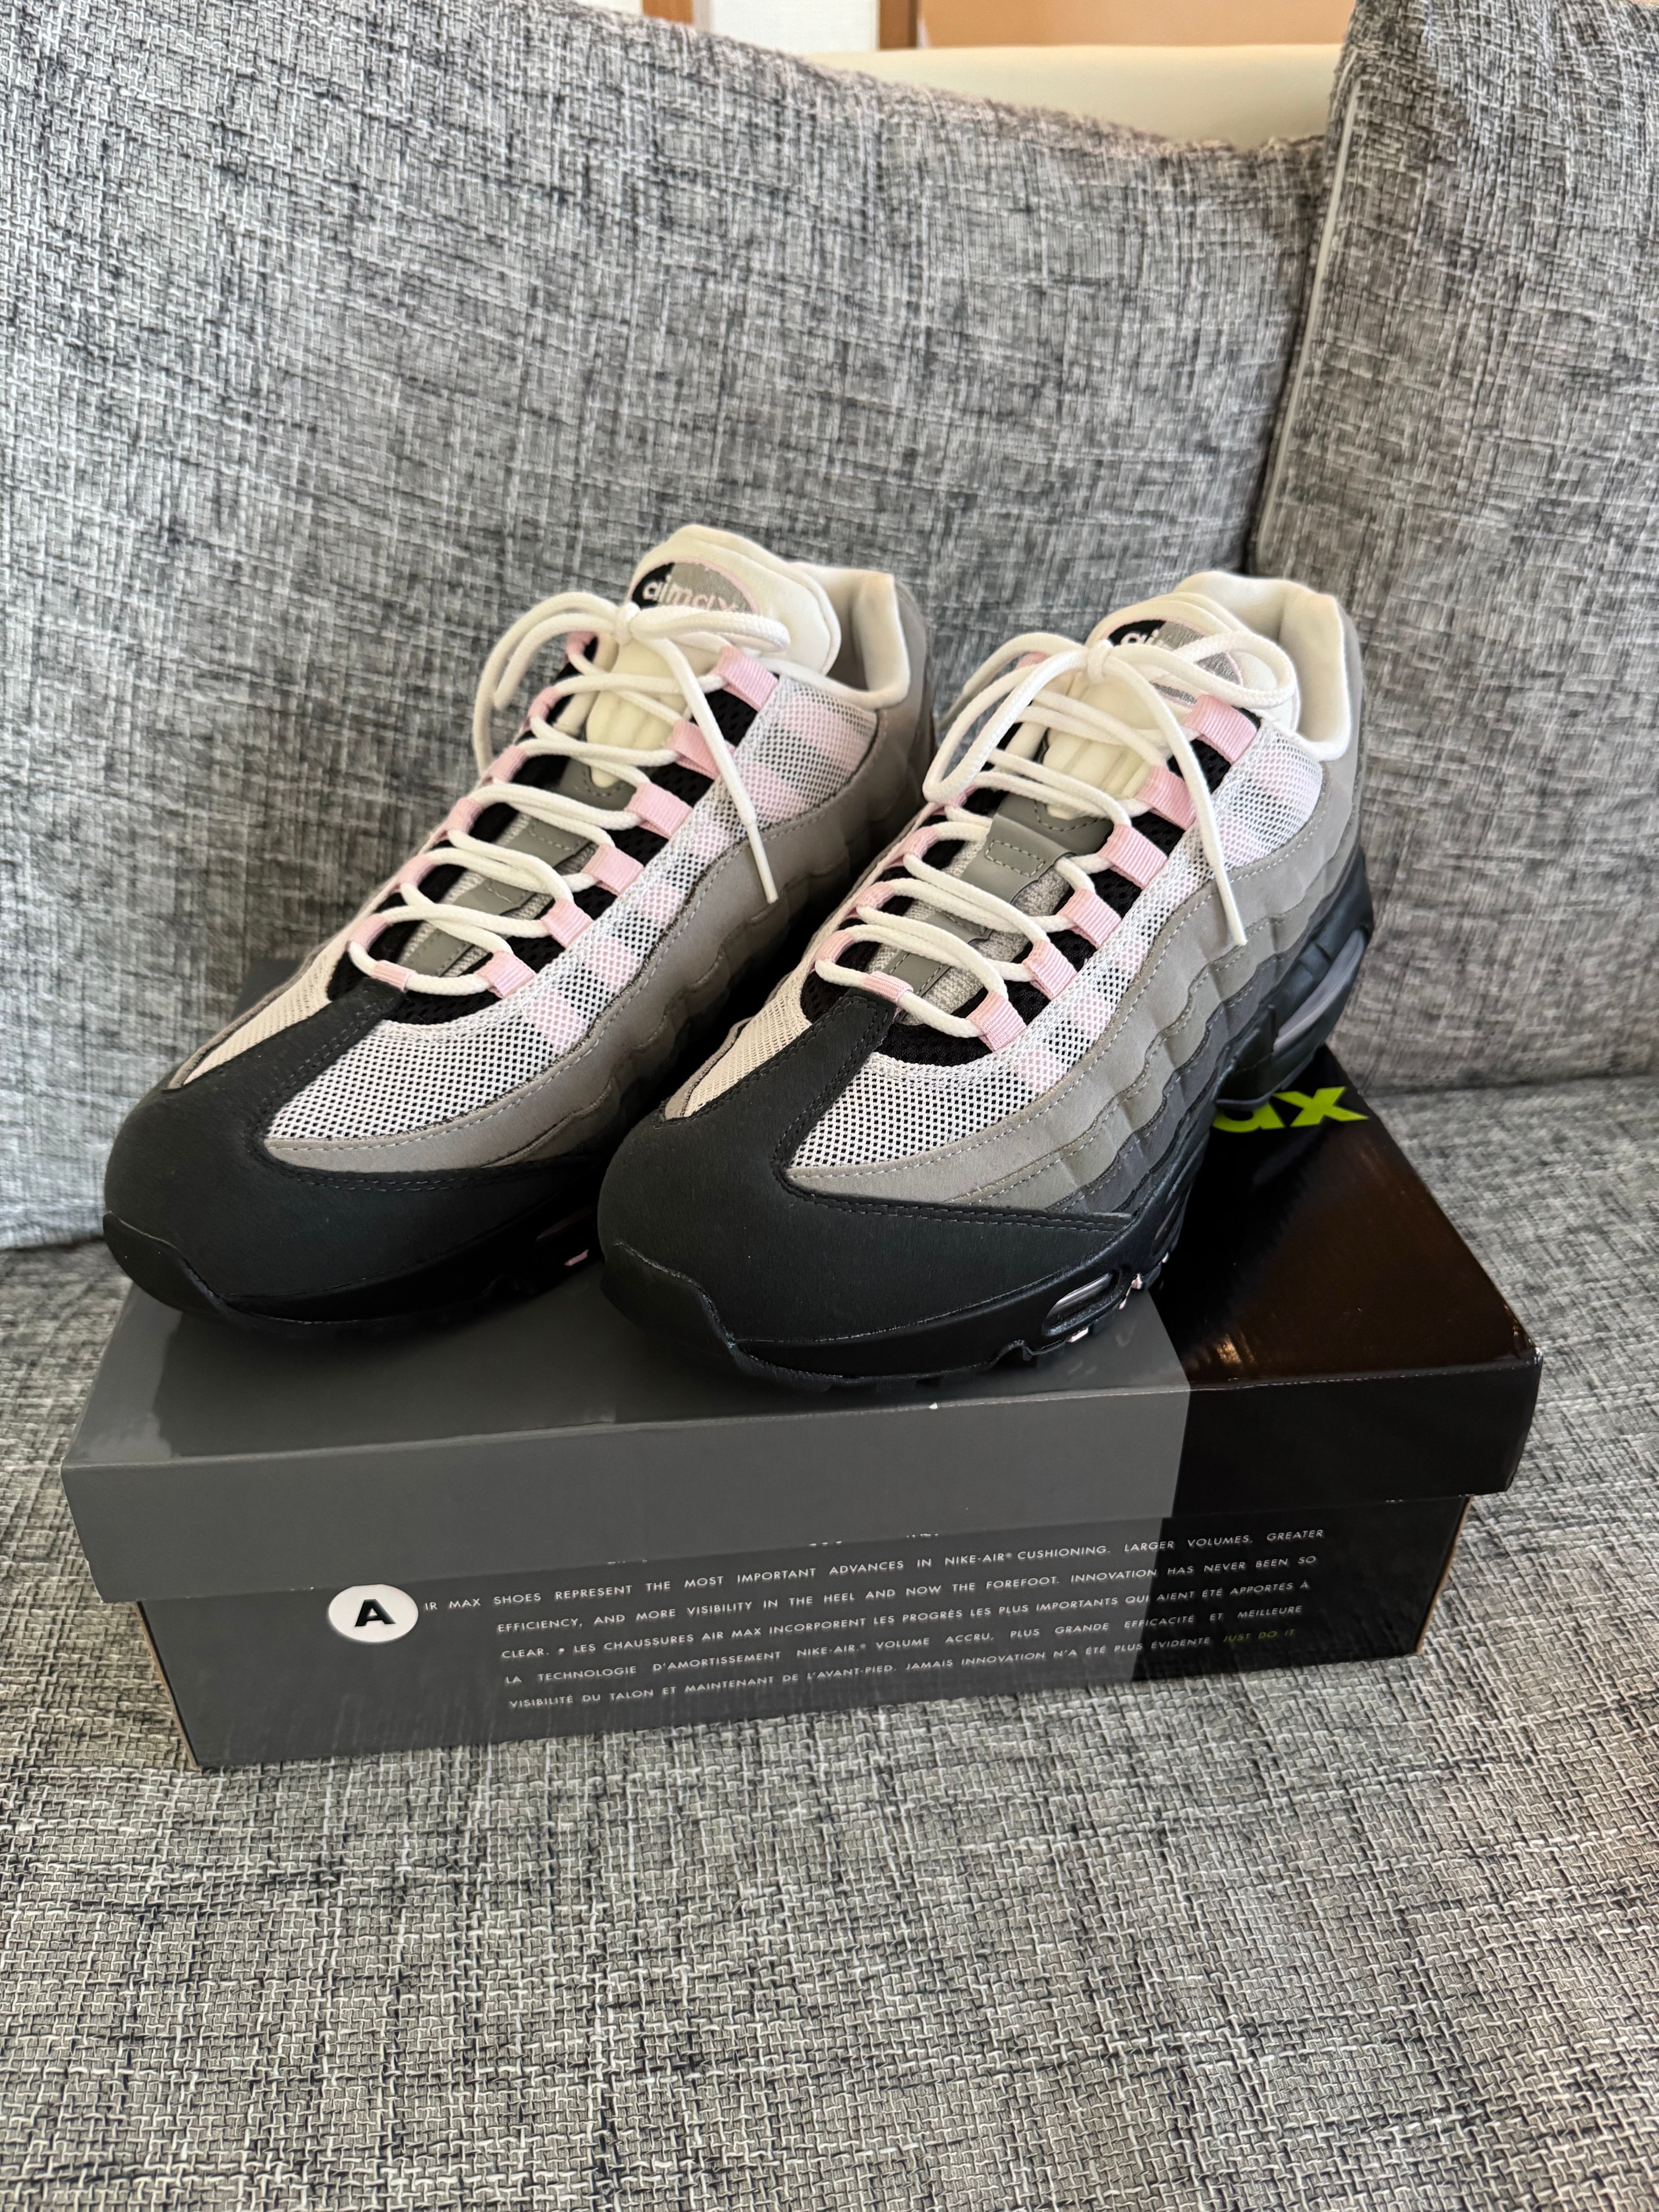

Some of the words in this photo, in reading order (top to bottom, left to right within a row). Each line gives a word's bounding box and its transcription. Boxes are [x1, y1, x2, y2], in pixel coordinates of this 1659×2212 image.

[354, 1598, 397, 1628] A
[424, 1602, 438, 1611] IR
[448, 1598, 481, 1609] MAX
[493, 1593, 541, 1606] SHOES
[555, 1585, 632, 1600] REPRESENT
[646, 1581, 671, 1592] THE
[684, 1576, 724, 1588] MOST
[737, 1568, 816, 1583] IMPORTANT
[829, 1560, 904, 1575] ADVANCES
[917, 1558, 932, 1568] IN
[1017, 1546, 1110, 1560] CUSHIONING.
[1124, 1540, 1175, 1553] LARGER
[1187, 1535, 1252, 1547] VOLUMES,
[1266, 1529, 1323, 1542] GREATER
[496, 1618, 582, 1633] EFFICIENCY,
[593, 1614, 625, 1626] AND
[635, 1609, 676, 1621] MORE
[687, 1601, 752, 1616] VISIBILITY
[763, 1599, 778, 1609] IN
[788, 1596, 812, 1607] THE
[824, 1592, 855, 1604] HEEL
[865, 1589, 896, 1599] AND
[906, 1585, 941, 1597] NOW
[952, 1582, 975, 1592] THE
[986, 1576, 1059, 1589] FOREFOOT.
[1071, 1569, 1157, 1583] INNOVATION
[1167, 1566, 1194, 1575] HAS
[1204, 1561, 1245, 1573] NEVER
[1255, 1558, 1288, 1568] BEEN
[1298, 1556, 1317, 1565] SO
[501, 1648, 549, 1659] CLEAR.
[573, 1644, 596, 1654] LES
[603, 1634, 694, 1651] CHAUSSURES
[701, 1631, 723, 1642] AIR
[731, 1627, 761, 1638] MAX
[769, 1618, 866, 1635] INCORPORENT
[873, 1615, 895, 1626] LES
[902, 1609, 963, 1623] PROGRÈS
[970, 1607, 991, 1618] LES
[998, 1604, 1029, 1615] PLUS
[1036, 1597, 1118, 1611] IMPORTANTS
[1125, 1595, 1149, 1604] QUI
[1156, 1591, 1195, 1602] AIENT
[1202, 1588, 1223, 1599] ÉTÉ
[1230, 1582, 1293, 1595] APPORTÉS
[505, 1676, 522, 1685] LA
[538, 1666, 636, 1682] TECHNOLOGIE
[876, 1637, 929, 1650] VOLUME
[1010, 1628, 1040, 1638] PLUS
[1054, 1623, 1109, 1635] GRANDE
[1124, 1615, 1194, 1629] EFFICACITÉ
[1209, 1613, 1223, 1621] ET
[1237, 1605, 1302, 1618] MEILLEURE
[509, 1694, 573, 1708] VISIBILITÉ
[581, 1694, 601, 1702] DU
[610, 1689, 654, 1701] TALON
[661, 1686, 676, 1696] ET
[684, 1676, 774, 1693] MAINTENANT
[782, 1674, 799, 1683] DE
[906, 1659, 953, 1671] JAMAIS
[961, 1652, 1046, 1666] INNOVATION
[1085, 1645, 1106, 1656] ÉTÉ
[1114, 1643, 1143, 1652] PLUS
[1151, 1637, 1210, 1650] ÉVIDENTE
[1223, 1633, 1250, 1642] JUST
[1258, 1631, 1277, 1639] DO
